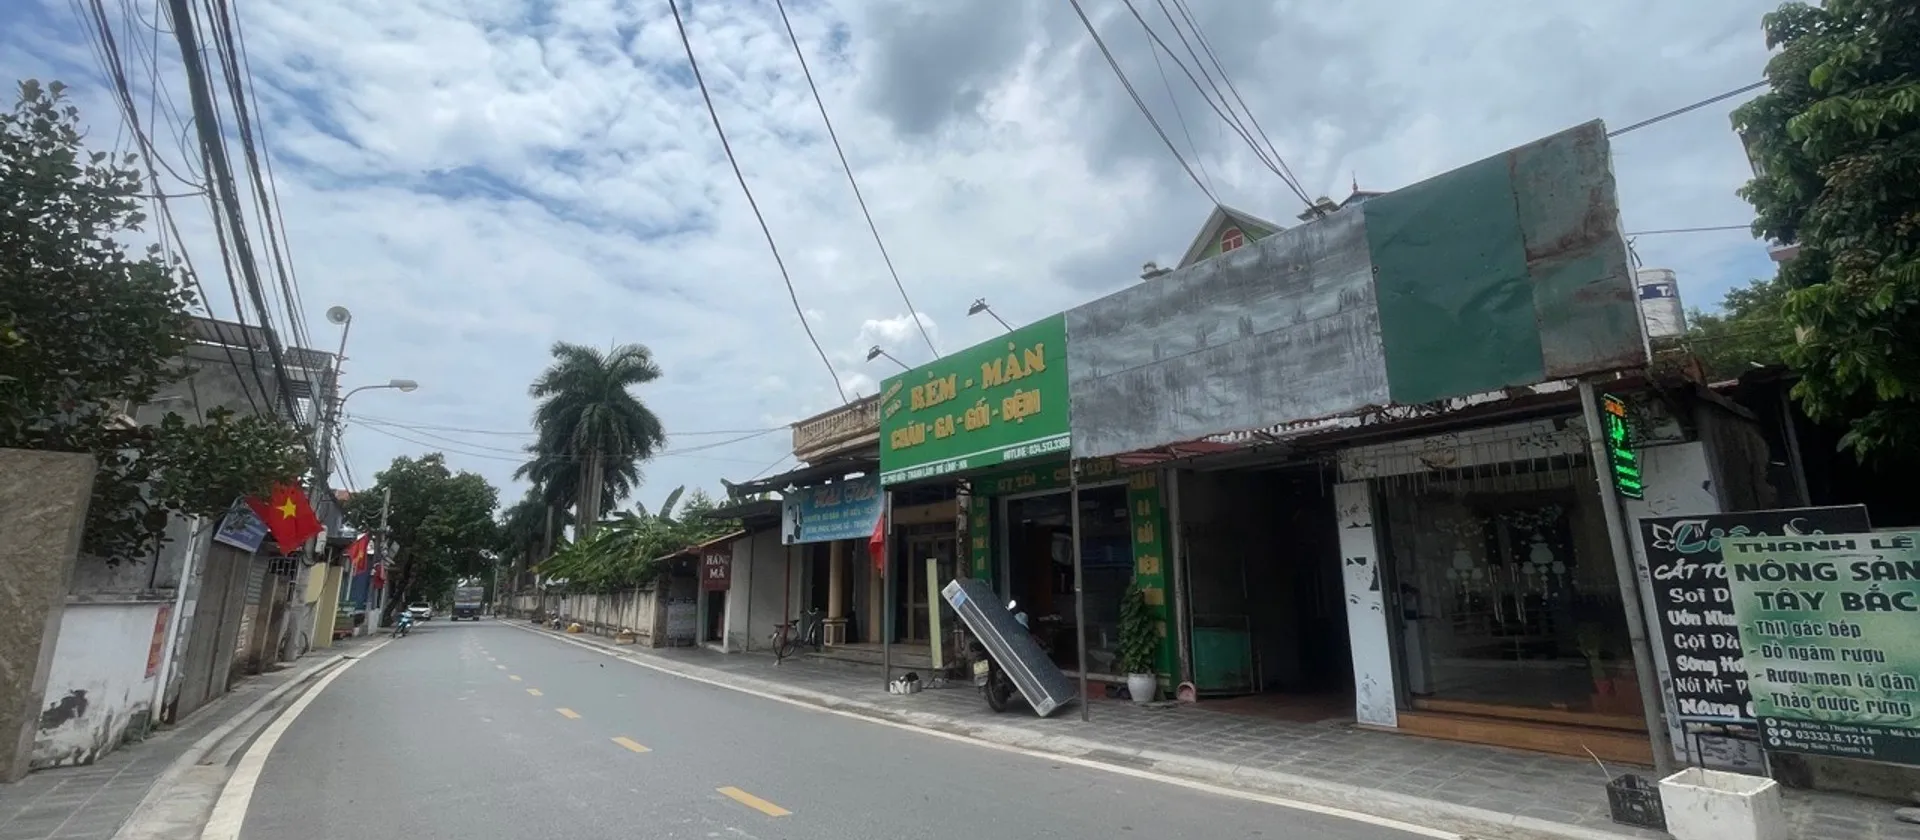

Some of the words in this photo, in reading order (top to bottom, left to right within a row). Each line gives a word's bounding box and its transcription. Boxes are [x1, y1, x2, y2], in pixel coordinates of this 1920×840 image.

[911, 371, 957, 412] RÈM
[981, 342, 1046, 389] MÀN
[891, 420, 925, 449] CHĂN
[935, 414, 955, 439] GA
[965, 397, 989, 431] GỐI
[1003, 388, 1040, 424] ĐỆM
[1732, 540, 1857, 553] THANH
[1702, 561, 1728, 579] TÓ
[1734, 559, 1838, 582] NÔNG
[1850, 555, 1920, 581] SẢN
[1712, 587, 1730, 603] D
[1754, 587, 1825, 611] TÂY
[1840, 583, 1918, 612] BẮC
[1703, 610, 1738, 627] Nhu
[1792, 621, 1824, 637] gác
[1788, 645, 1836, 661] ngâm
[1814, 671, 1852, 687] men
[1771, 692, 1811, 709] Thảo
[1795, 730, 1873, 746] 03333.6.1211
